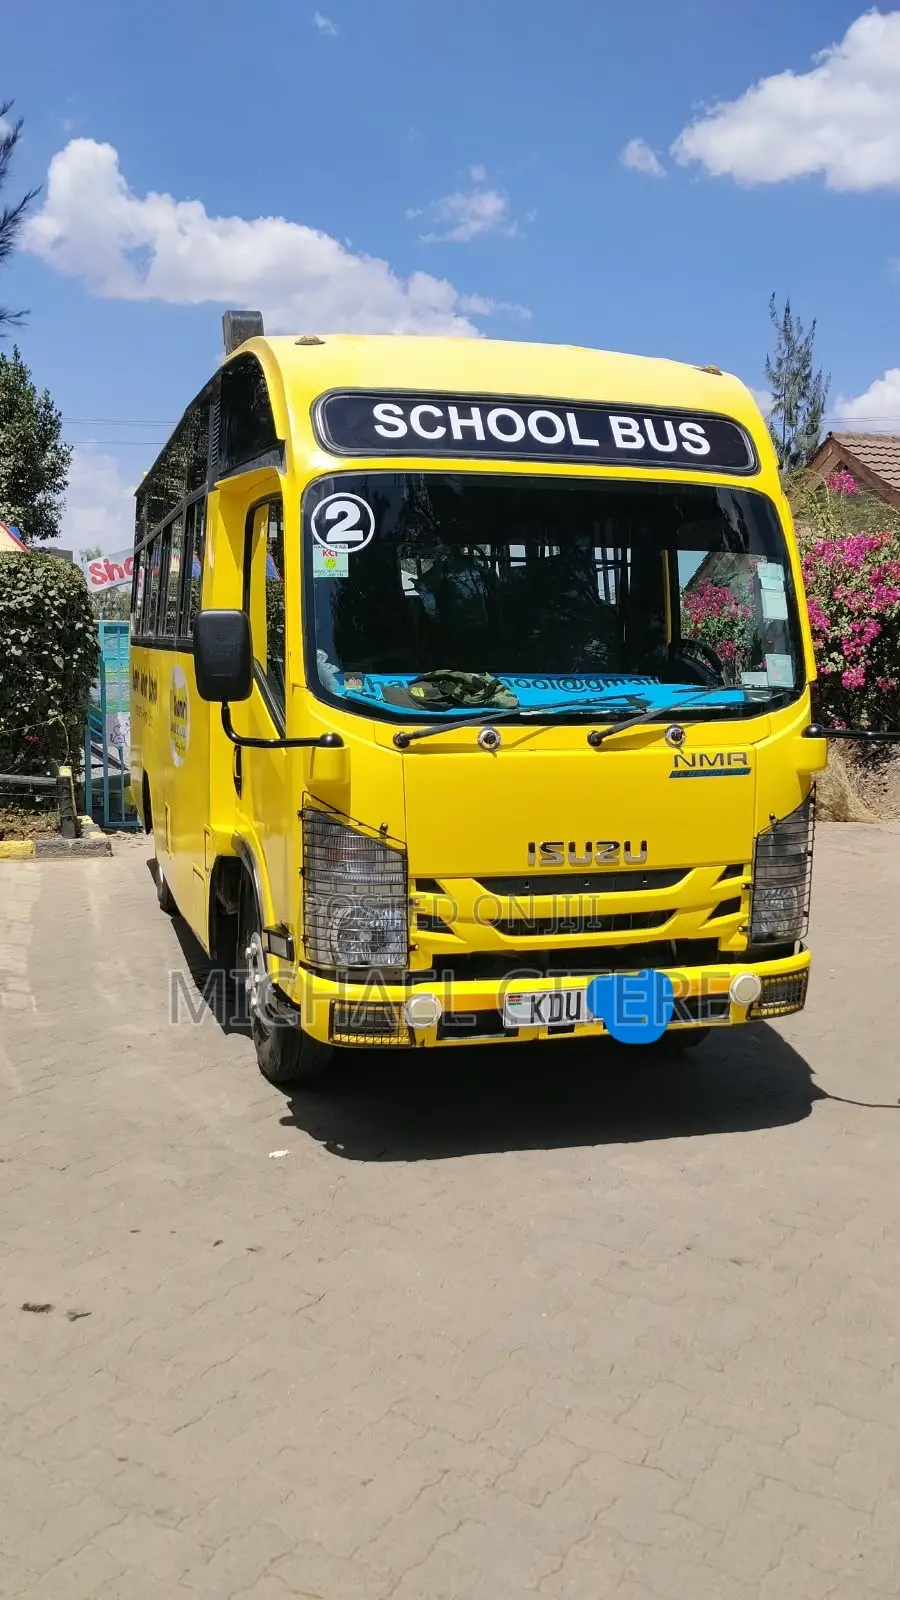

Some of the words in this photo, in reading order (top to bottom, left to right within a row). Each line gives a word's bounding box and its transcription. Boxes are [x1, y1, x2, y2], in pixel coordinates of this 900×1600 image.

[373, 403, 599, 447] SCHOOL
[608, 415, 712, 455] BUS
[325, 500, 364, 542] 2
[673, 752, 748, 767] NMR
[528, 841, 647, 866] ISUZU
[530, 992, 582, 1024] KDU
